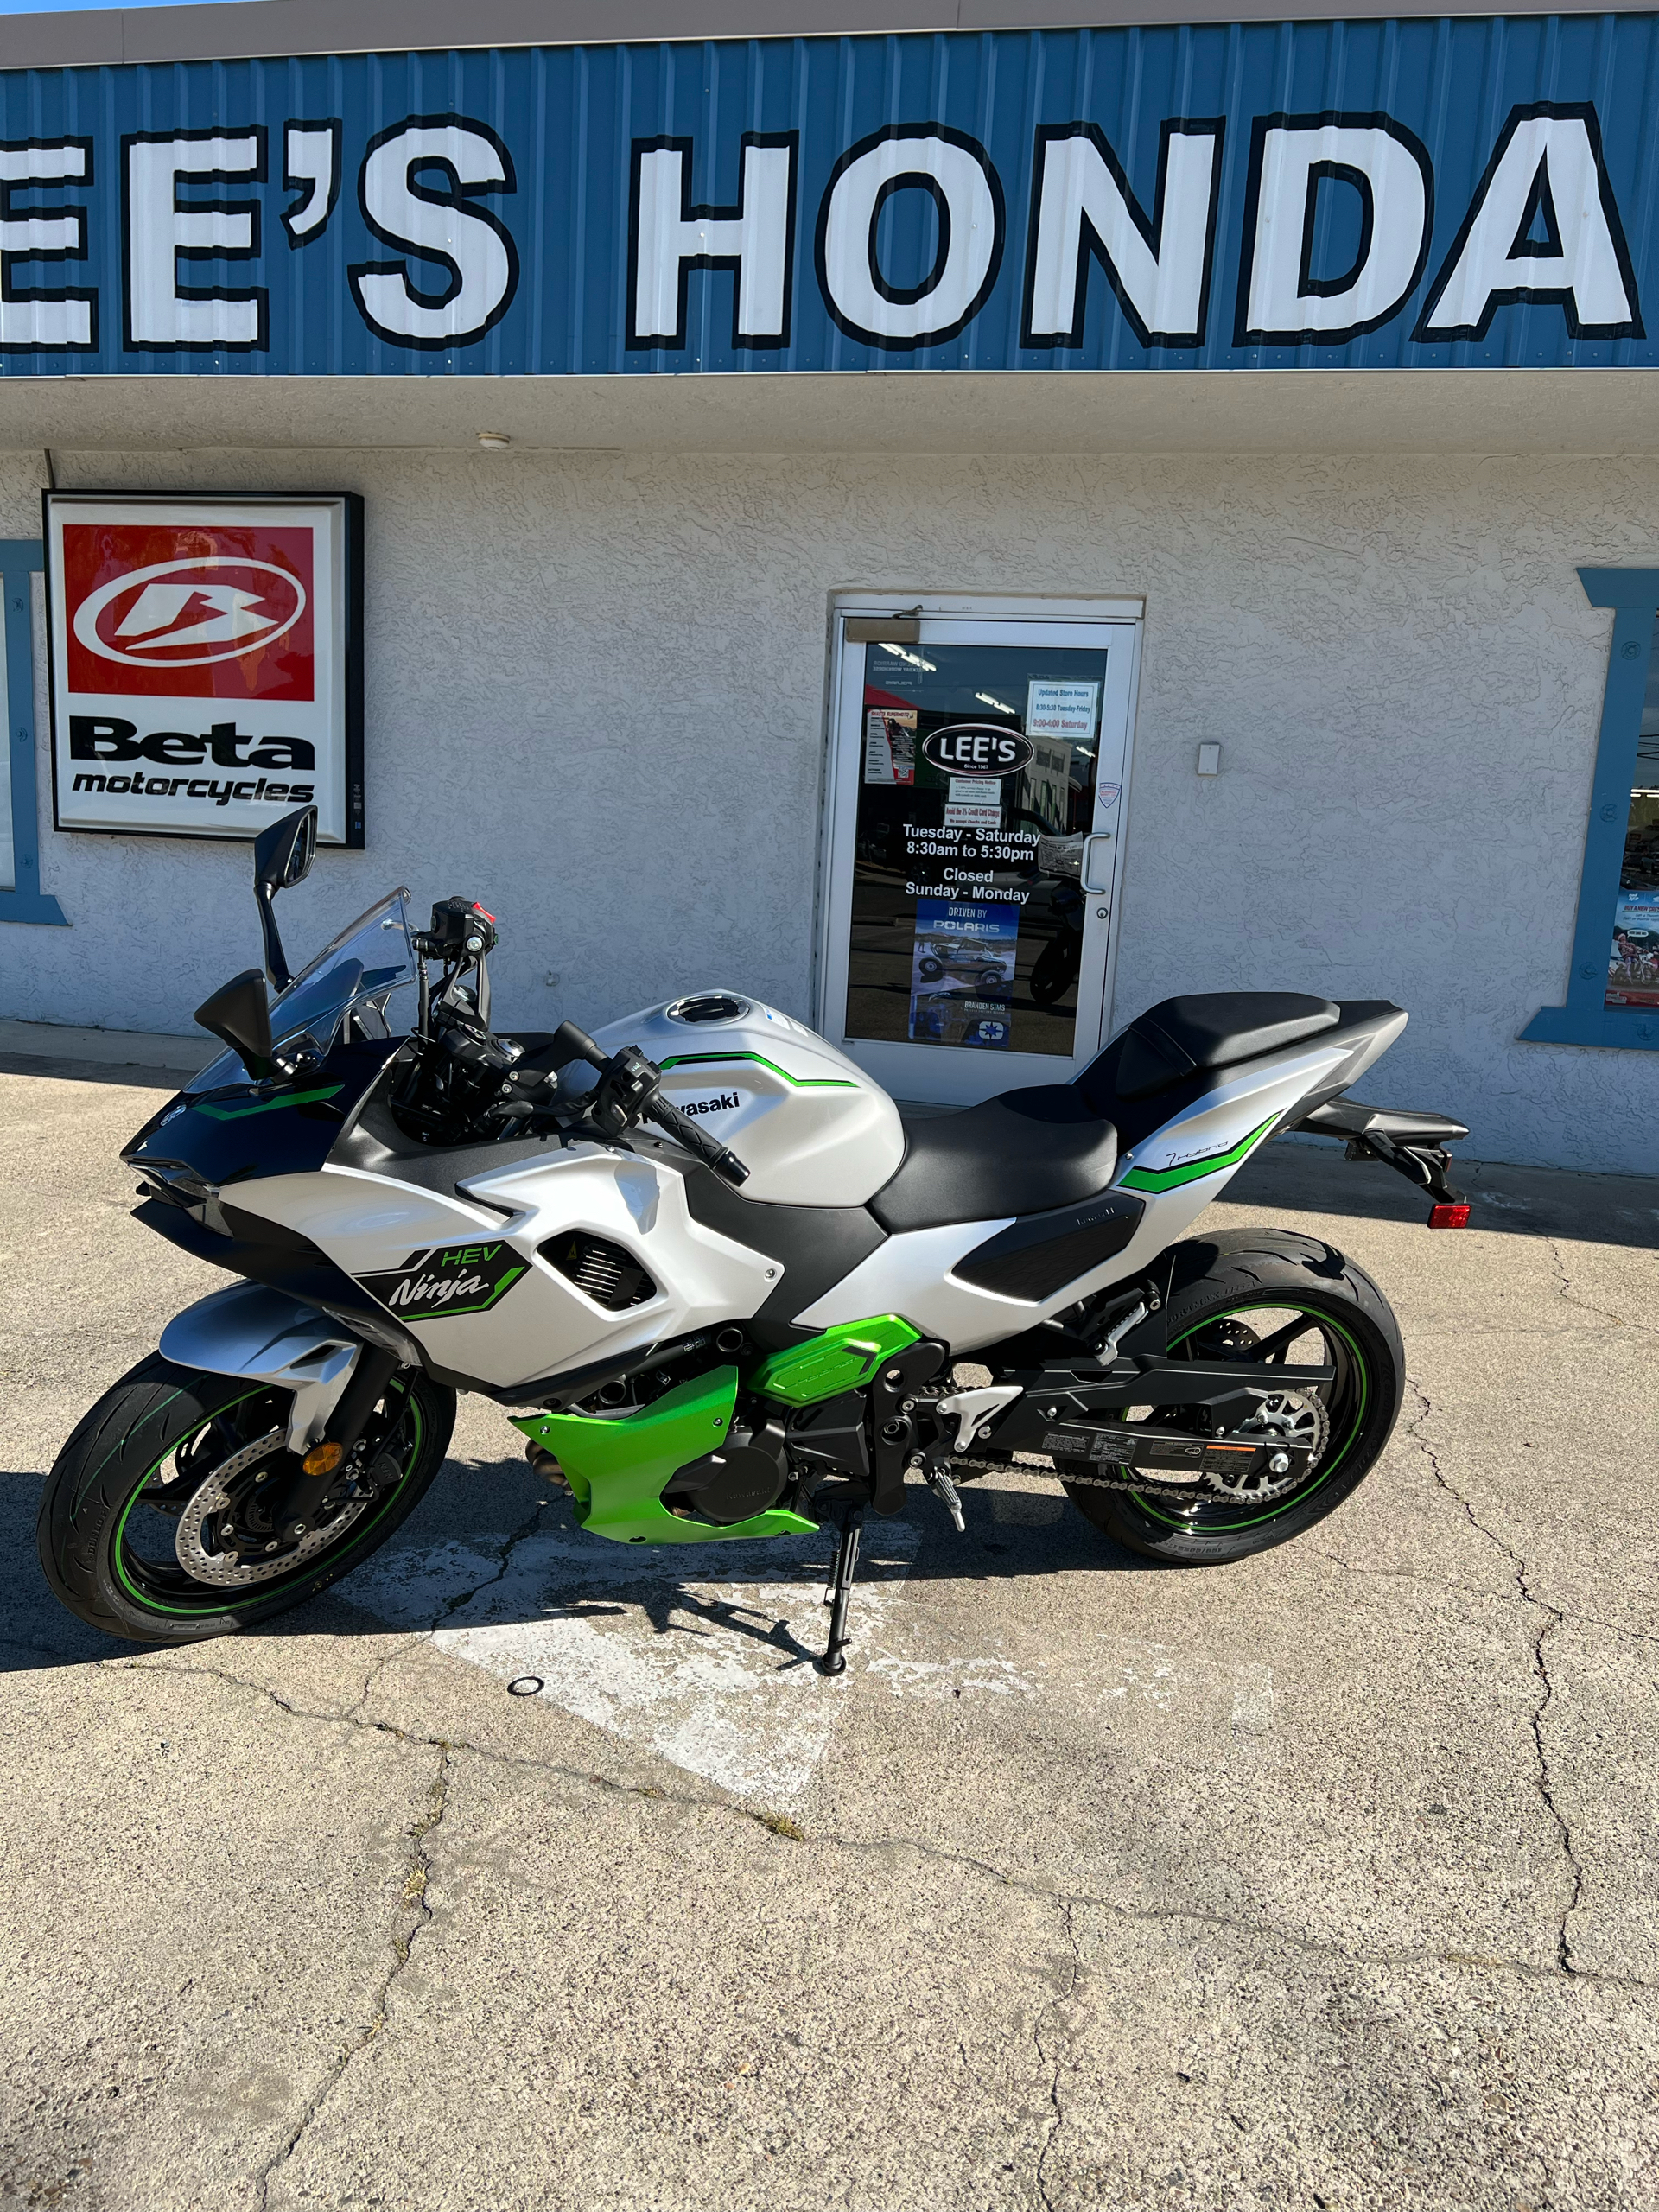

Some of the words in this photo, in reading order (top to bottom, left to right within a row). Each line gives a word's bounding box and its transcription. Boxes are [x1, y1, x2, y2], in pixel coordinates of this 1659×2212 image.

[0, 113, 519, 353] EE'S
[626, 100, 1647, 351] HONDA
[1038, 688, 1058, 697] Updated
[1061, 719, 1088, 731] Saturday
[68, 715, 315, 771] Beta
[940, 736, 1016, 763] LEE'S
[72, 771, 315, 806] motorcycles
[903, 824, 963, 843] Tuesday
[975, 828, 1041, 847] Saturday
[907, 841, 958, 856] 8:30am
[962, 844, 976, 857] to
[980, 845, 1034, 863] 5:30pm
[943, 867, 994, 882] Closed
[905, 882, 959, 900] Sunday
[972, 886, 1030, 904] Monday
[948, 907, 975, 917] DRIVEN
[977, 909, 987, 918] BY
[933, 920, 1000, 933] POLARIS
[964, 1001, 989, 1010] BRANDEN
[676, 1091, 740, 1116] asaki
[440, 1244, 502, 1267] HEV
[388, 1268, 490, 1309] Ninja
